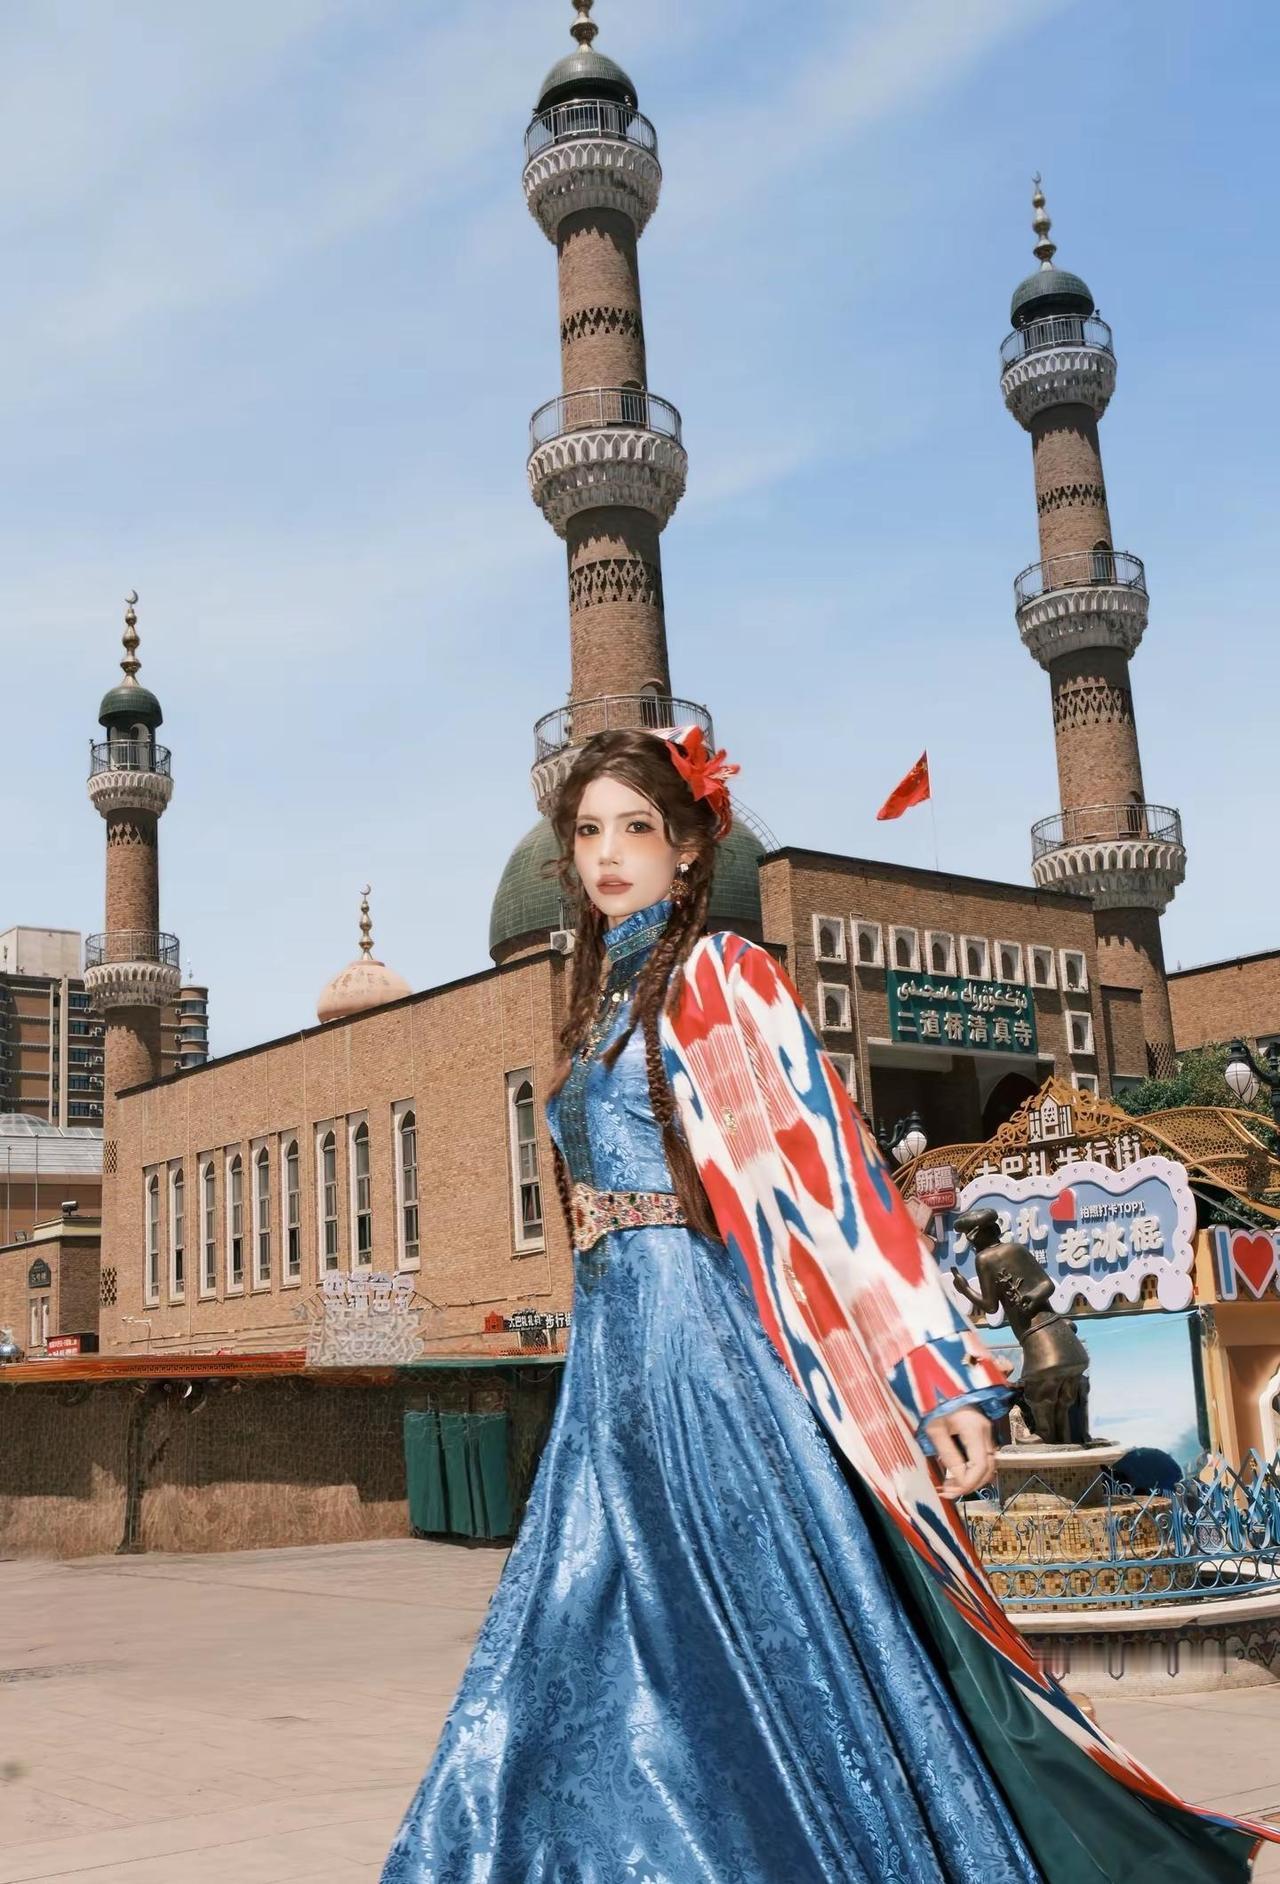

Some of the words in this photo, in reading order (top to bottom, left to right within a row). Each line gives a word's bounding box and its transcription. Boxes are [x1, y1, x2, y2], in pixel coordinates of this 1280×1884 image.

[897, 1009, 1033, 1047] 二道桥清真寺
[916, 1167, 953, 1194] 新疆
[1056, 1216, 1164, 1268] 老冰棍
